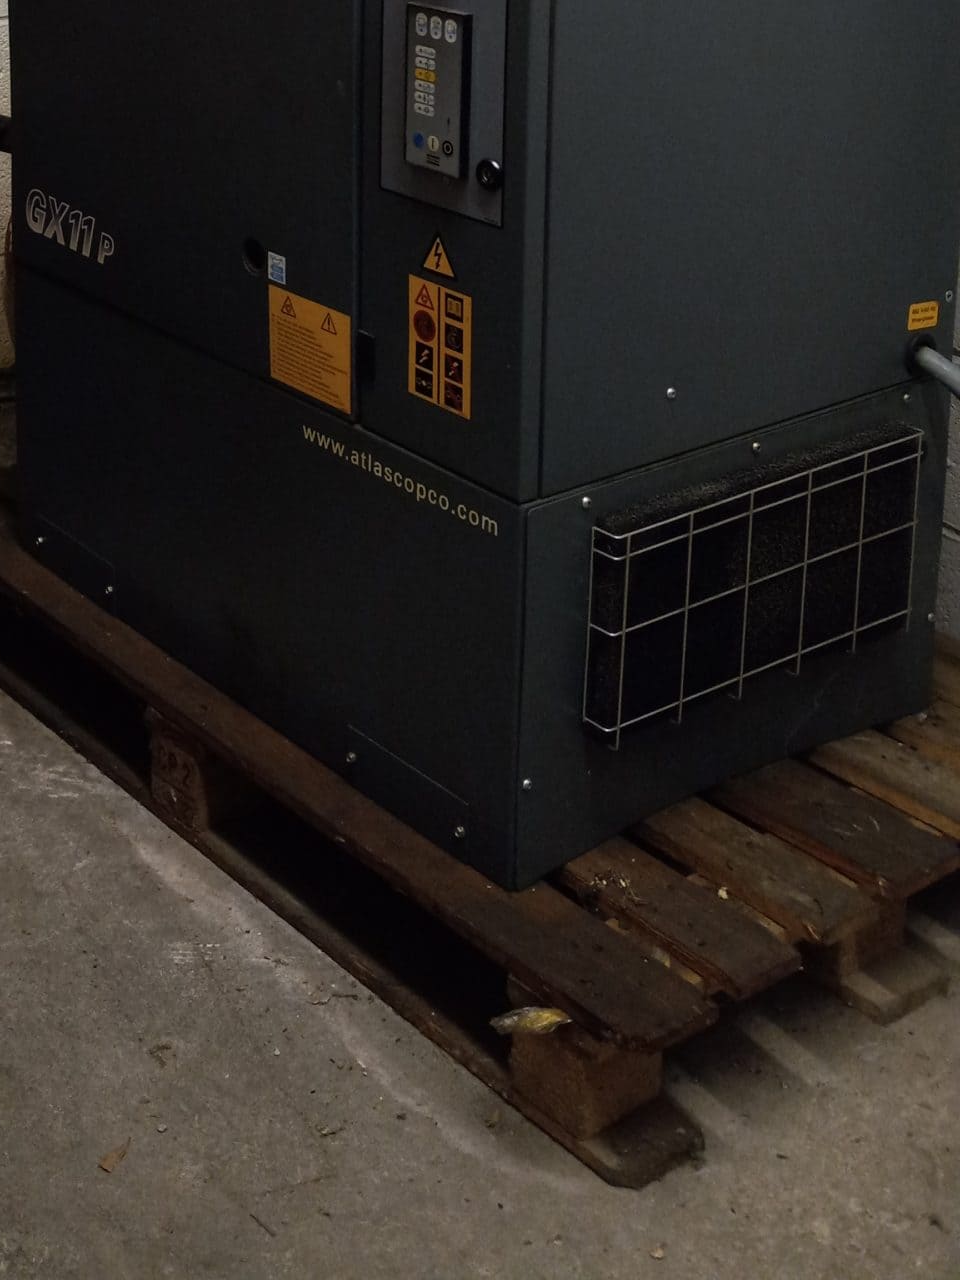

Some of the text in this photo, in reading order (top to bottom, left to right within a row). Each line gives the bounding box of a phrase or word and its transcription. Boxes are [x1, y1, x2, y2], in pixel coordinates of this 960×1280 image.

[25, 188, 115, 264] GX11 P
[302, 424, 499, 536] www.atlascopco.com
